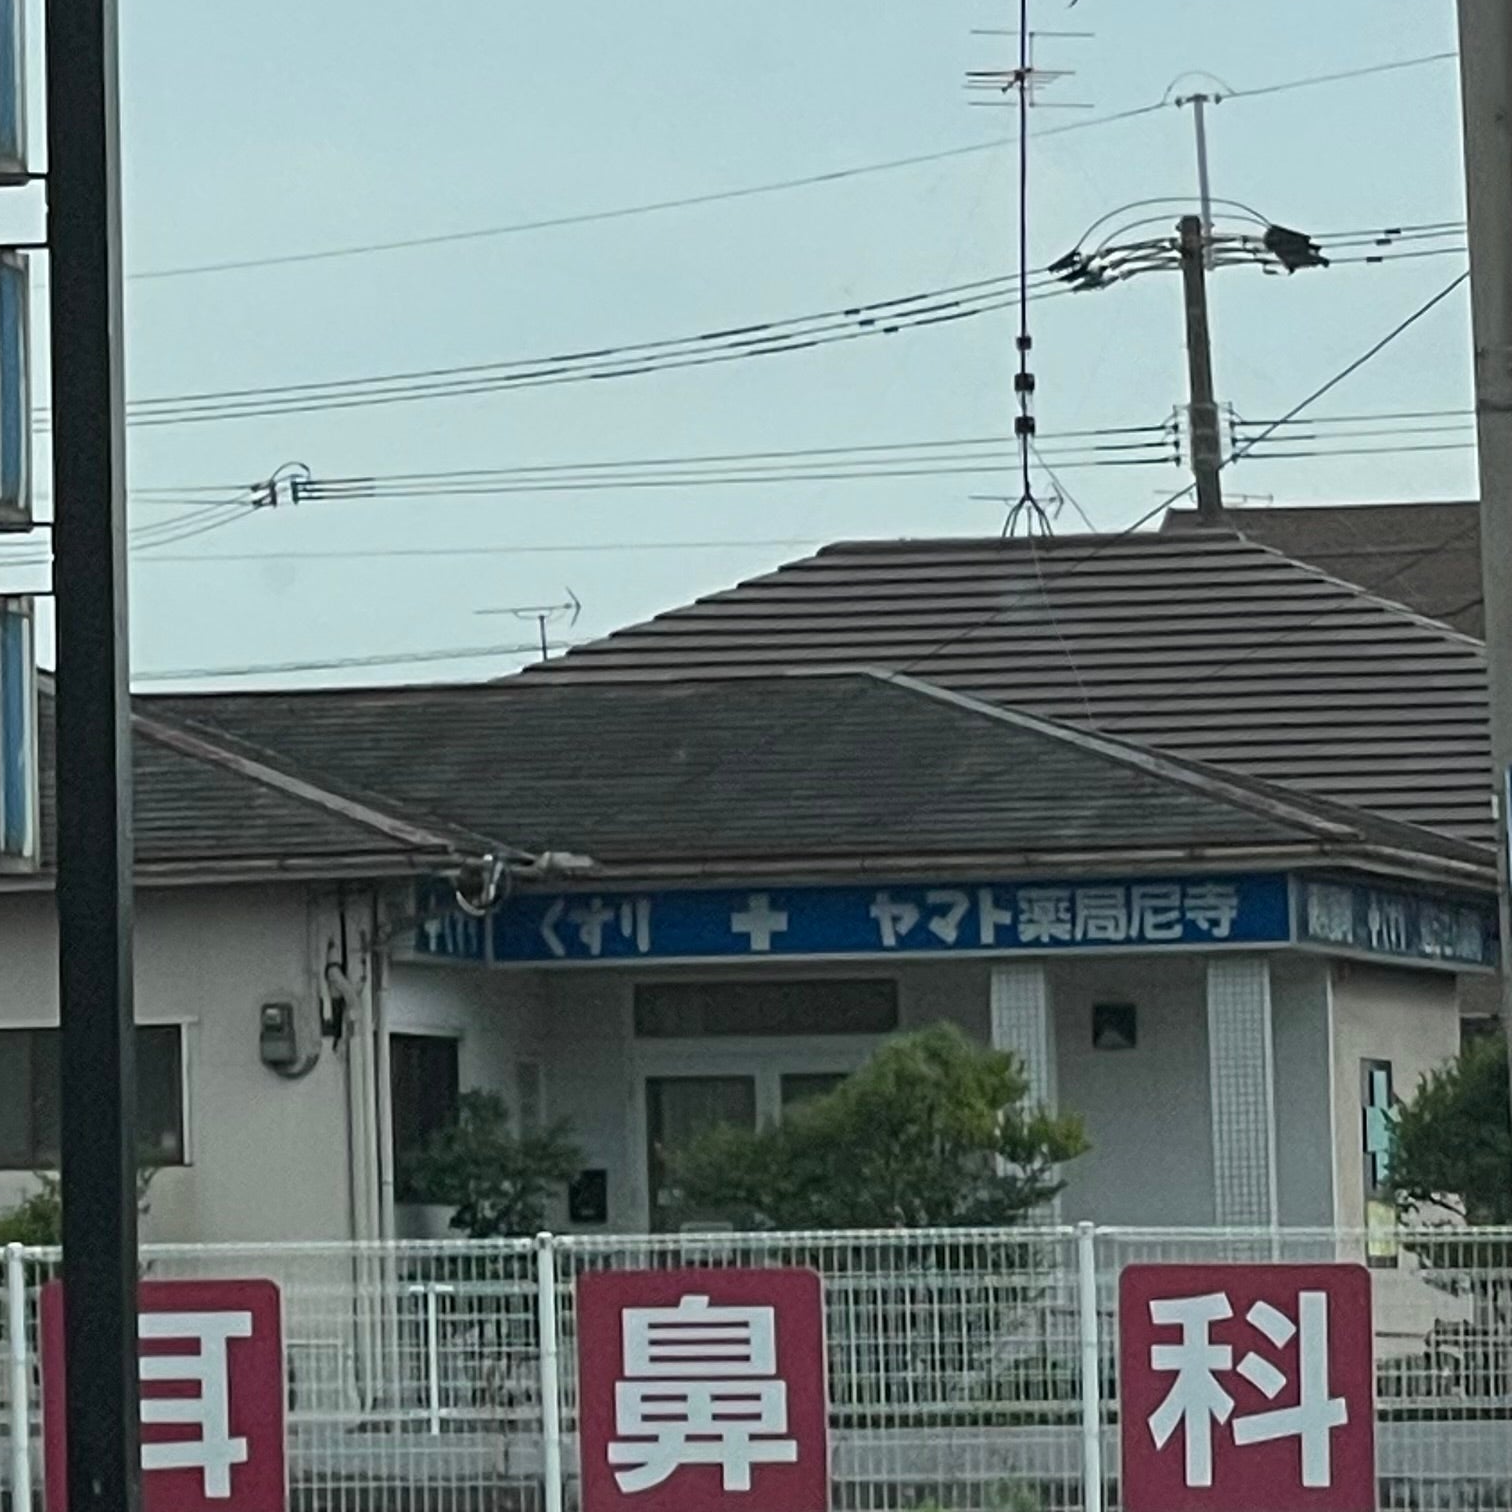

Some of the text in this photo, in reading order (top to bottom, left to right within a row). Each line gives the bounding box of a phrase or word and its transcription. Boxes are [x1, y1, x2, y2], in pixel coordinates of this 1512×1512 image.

[540, 897, 651, 957] くすり
[869, 884, 1239, 947] ヤマト薬局尼寺
